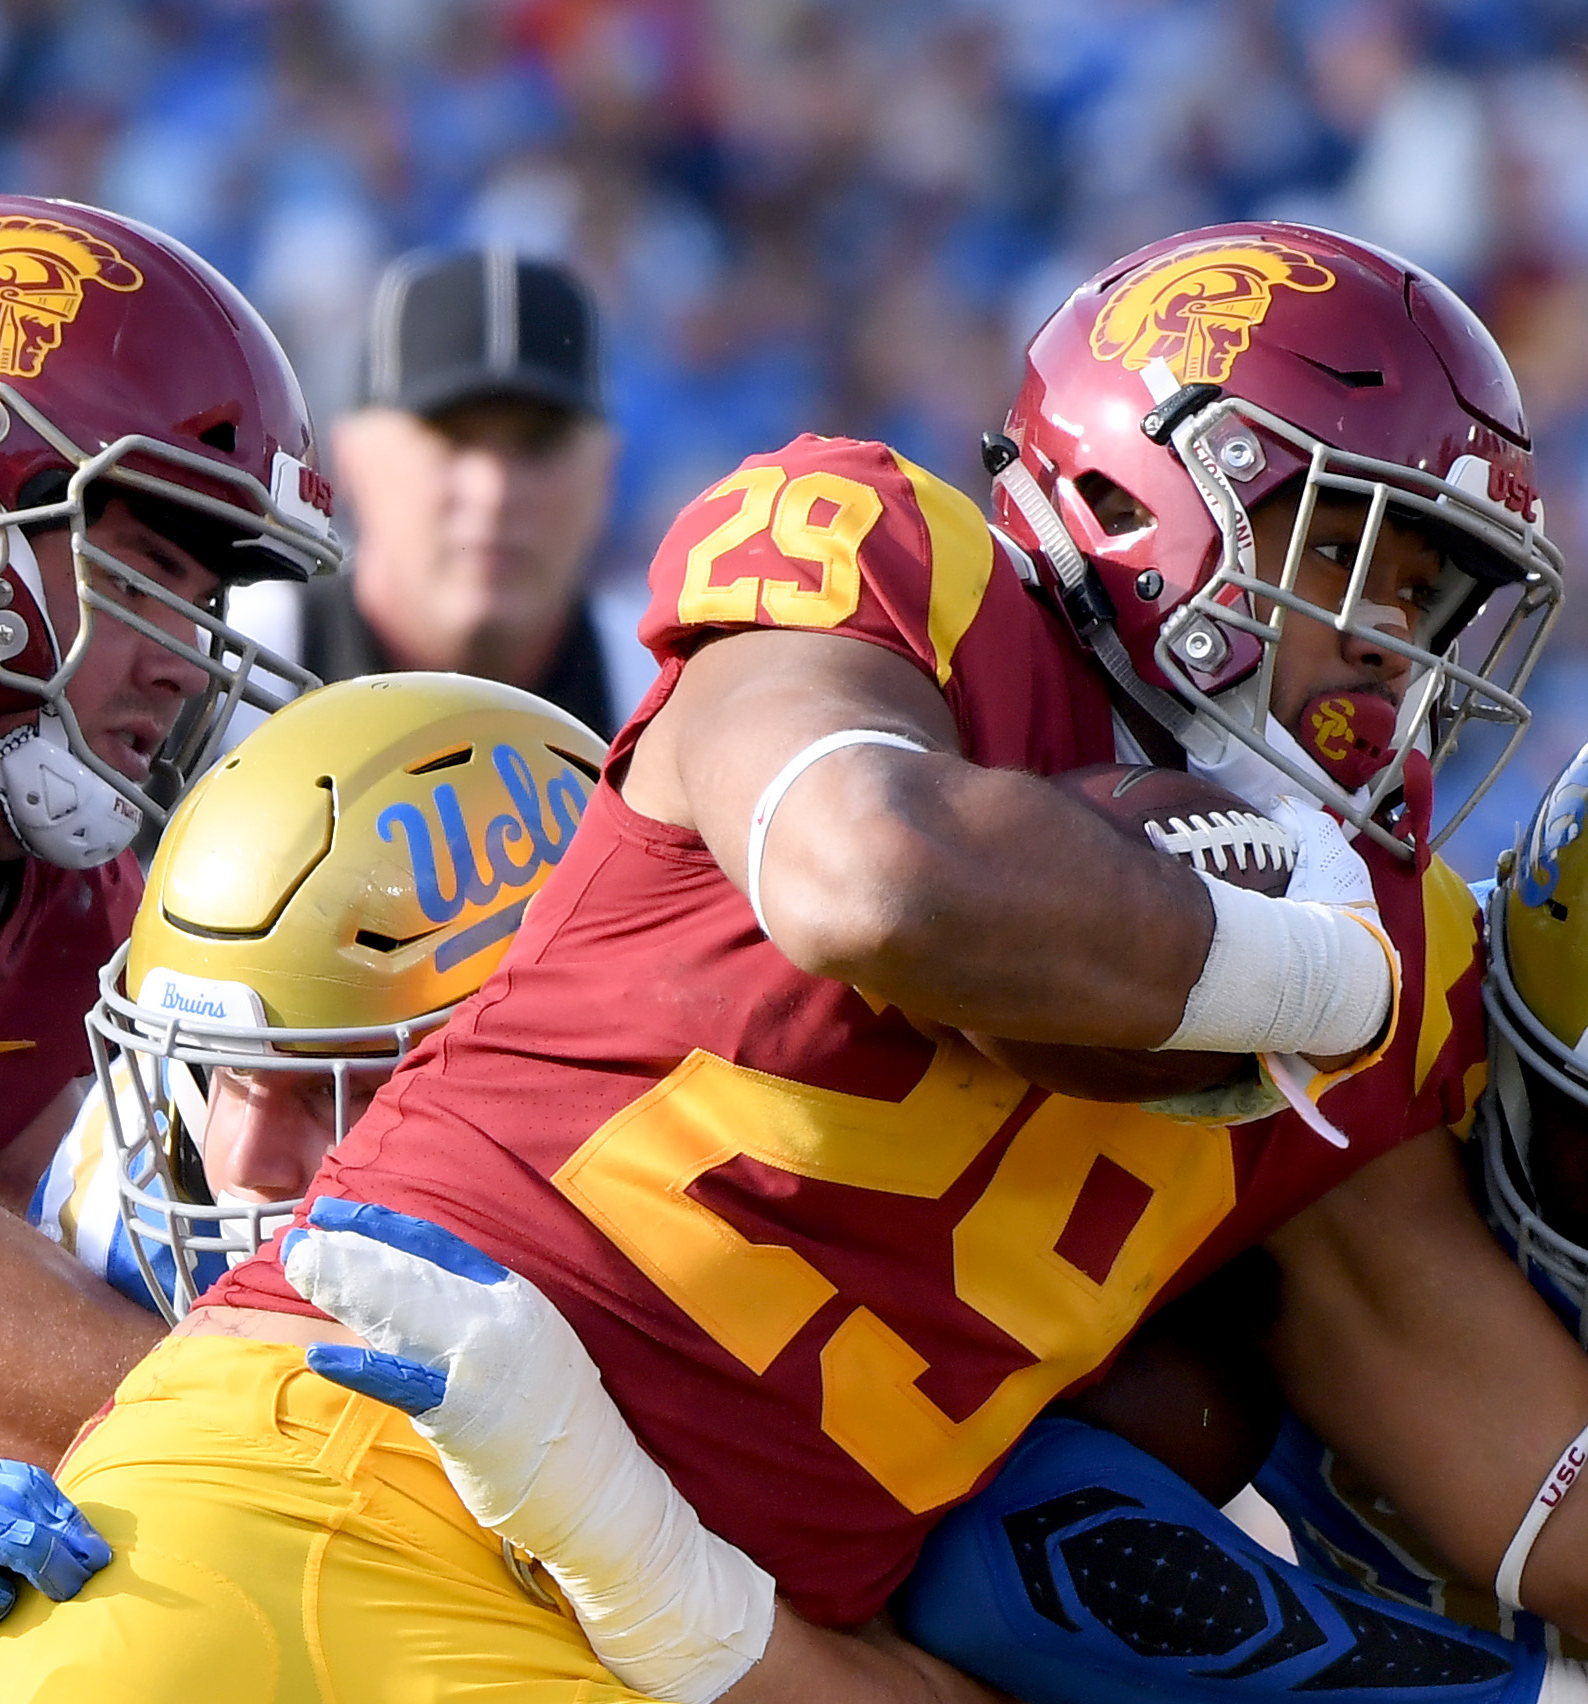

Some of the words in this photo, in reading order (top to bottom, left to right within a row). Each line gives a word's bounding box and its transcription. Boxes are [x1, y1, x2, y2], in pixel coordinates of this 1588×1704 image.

[677, 465, 884, 628] 29
[160, 982, 228, 1020] Bruins
[549, 1045, 1237, 1515] 29
[1540, 1446, 1587, 1508] USC
